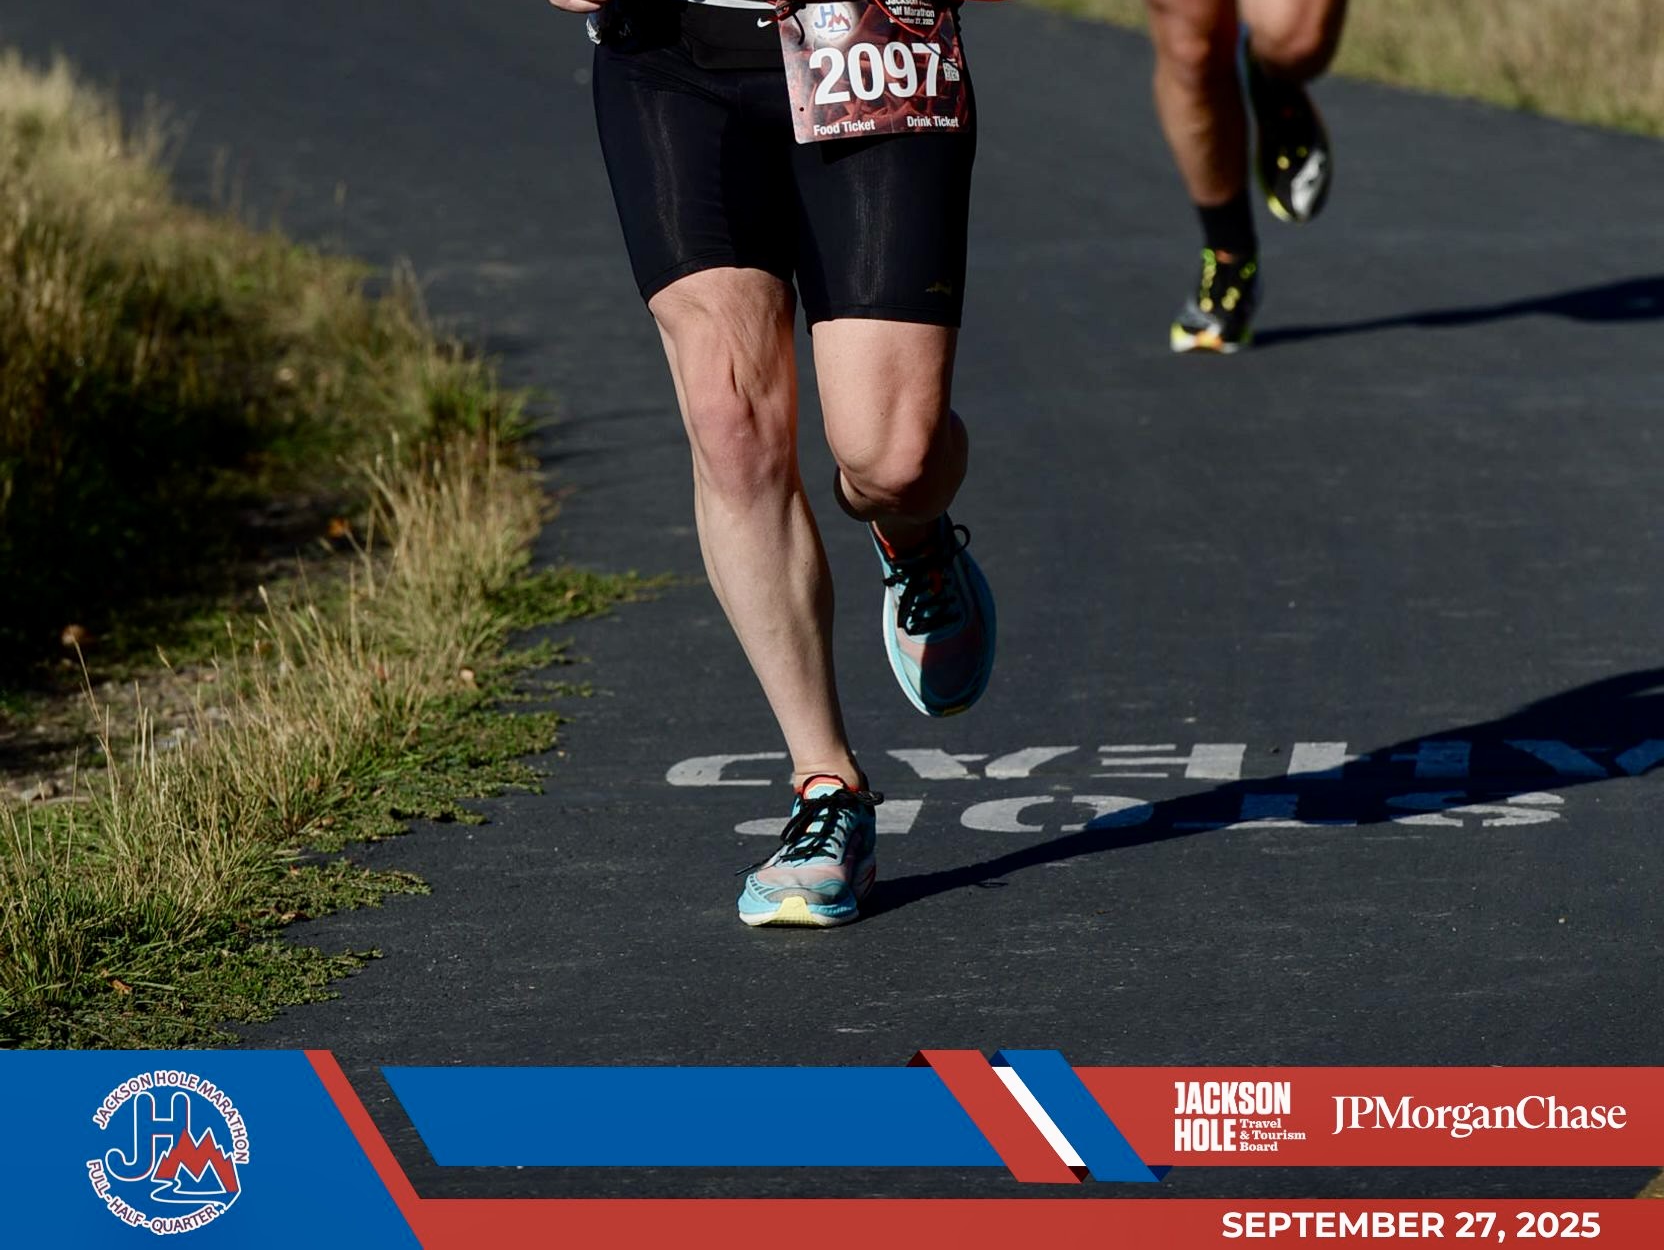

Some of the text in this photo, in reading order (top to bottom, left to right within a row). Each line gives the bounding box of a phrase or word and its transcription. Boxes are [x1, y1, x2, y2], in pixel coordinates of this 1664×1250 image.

[904, 6, 935, 18] Marathon
[809, 41, 941, 105] 2097
[813, 119, 876, 136] Food Ticket
[907, 116, 959, 128] Drink Ticket
